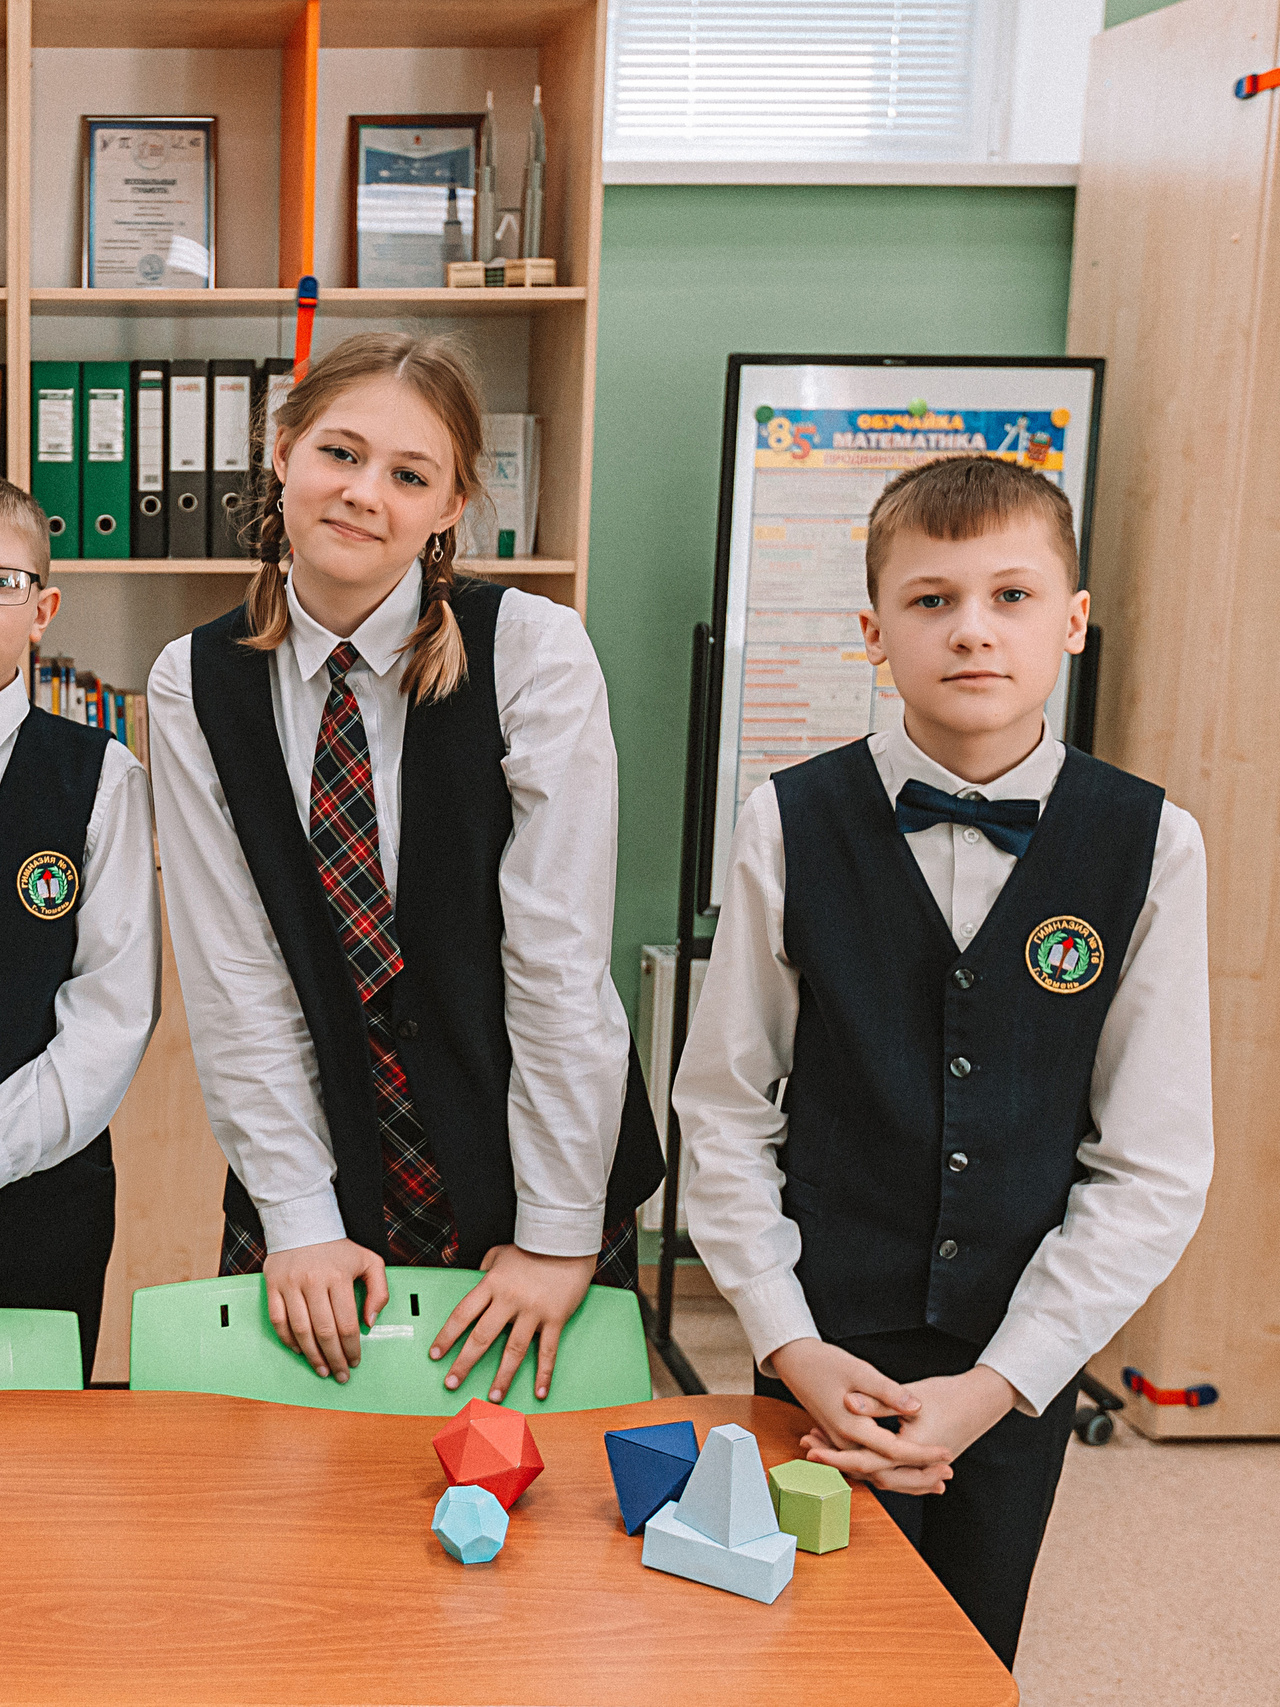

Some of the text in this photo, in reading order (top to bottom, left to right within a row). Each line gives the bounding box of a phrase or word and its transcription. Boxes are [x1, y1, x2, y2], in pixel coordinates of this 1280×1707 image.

[857, 411, 964, 431] ОБУЧАЙКА
[832, 432, 988, 450] МАТЕМАТИКА
[21, 856, 56, 889] ГИМНАЗИЯ
[66, 870, 73, 880] 16
[1033, 920, 1099, 964] ГИМНАЗИЯ № 16
